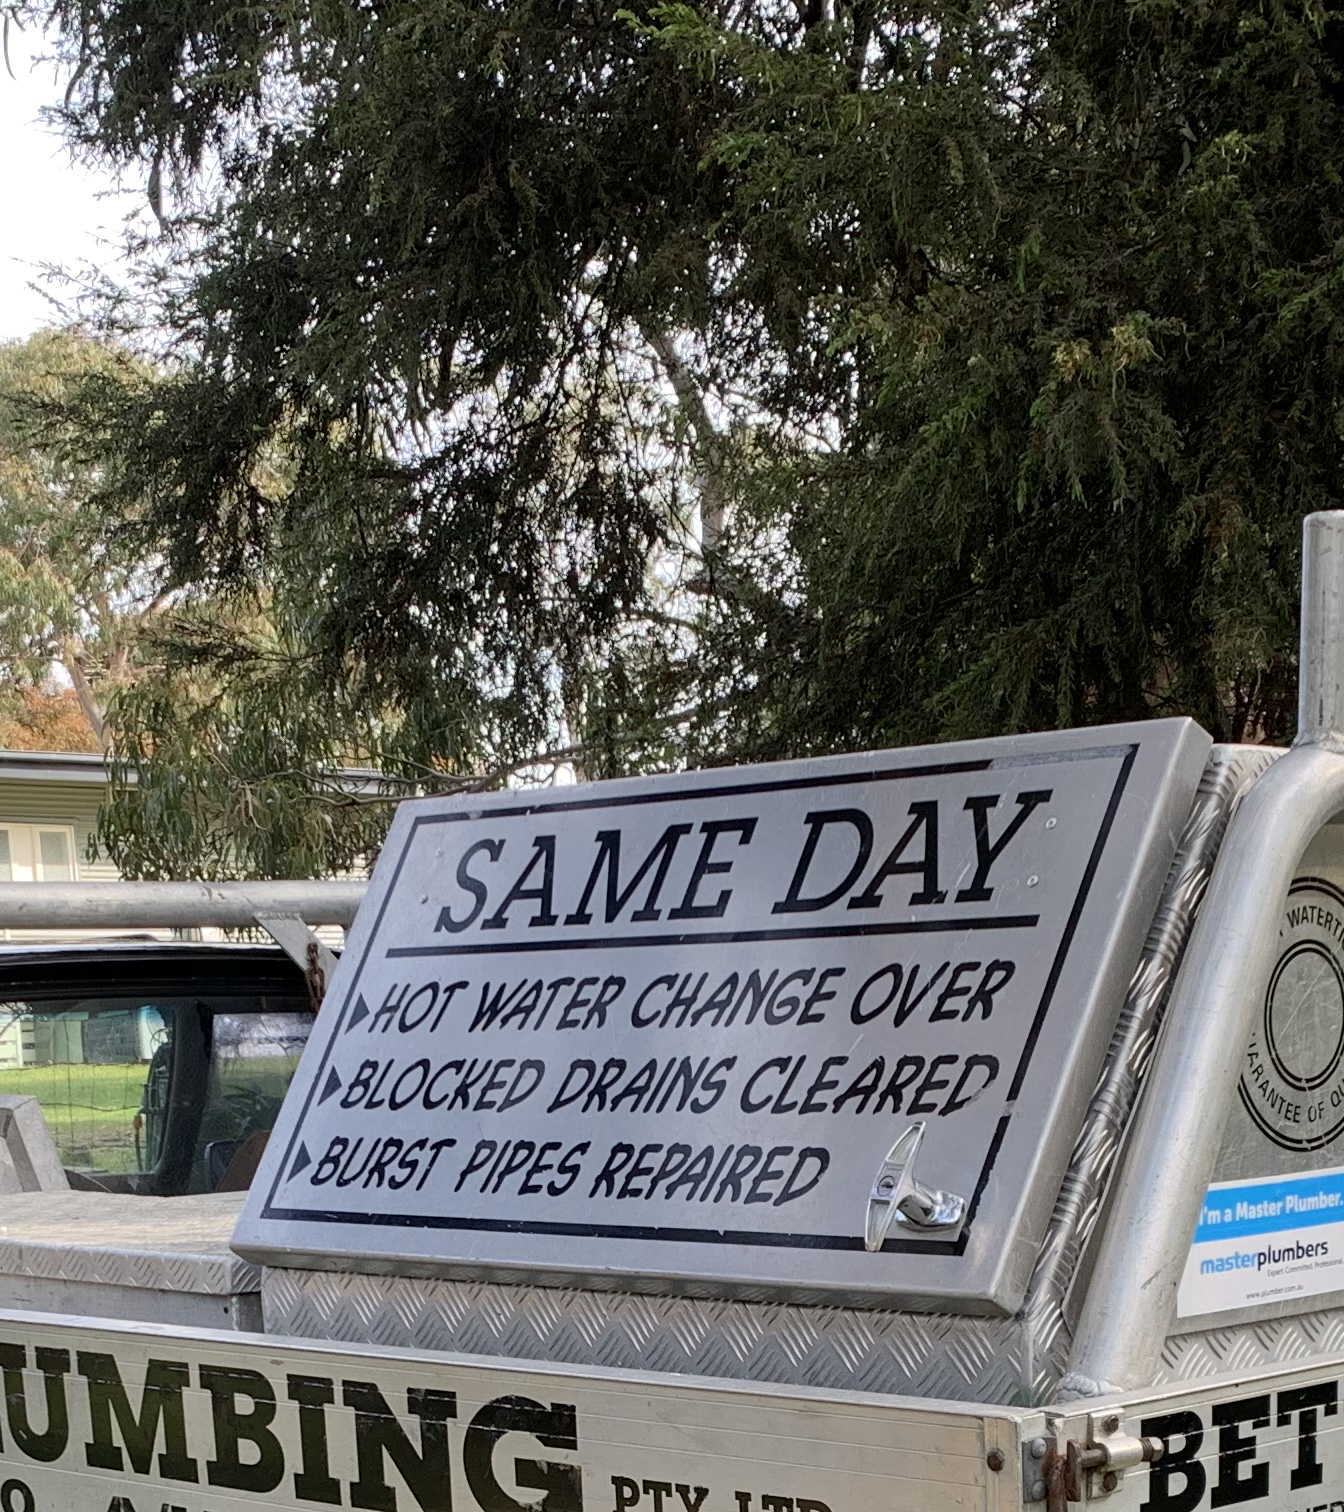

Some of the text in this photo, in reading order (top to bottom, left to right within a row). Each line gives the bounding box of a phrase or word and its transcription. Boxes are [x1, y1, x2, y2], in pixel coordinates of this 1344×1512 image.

[435, 789, 1053, 935] SAME DAY
[369, 958, 1018, 1035] HOT WATER CHANGE OVER
[340, 1053, 1000, 1117] BLOCKED DRAINS CLEARED
[1247, 1032, 1302, 1124] ARANTEE
[1308, 1101, 1325, 1124] OF
[309, 1135, 831, 1206] BURST PIPES REPAIRED
[1223, 1208, 1233, 1223] a
[1235, 1200, 1284, 1222] Master
[1285, 1190, 1344, 1214] Plumber.
[1200, 1239, 1329, 1276] masterplumbers
